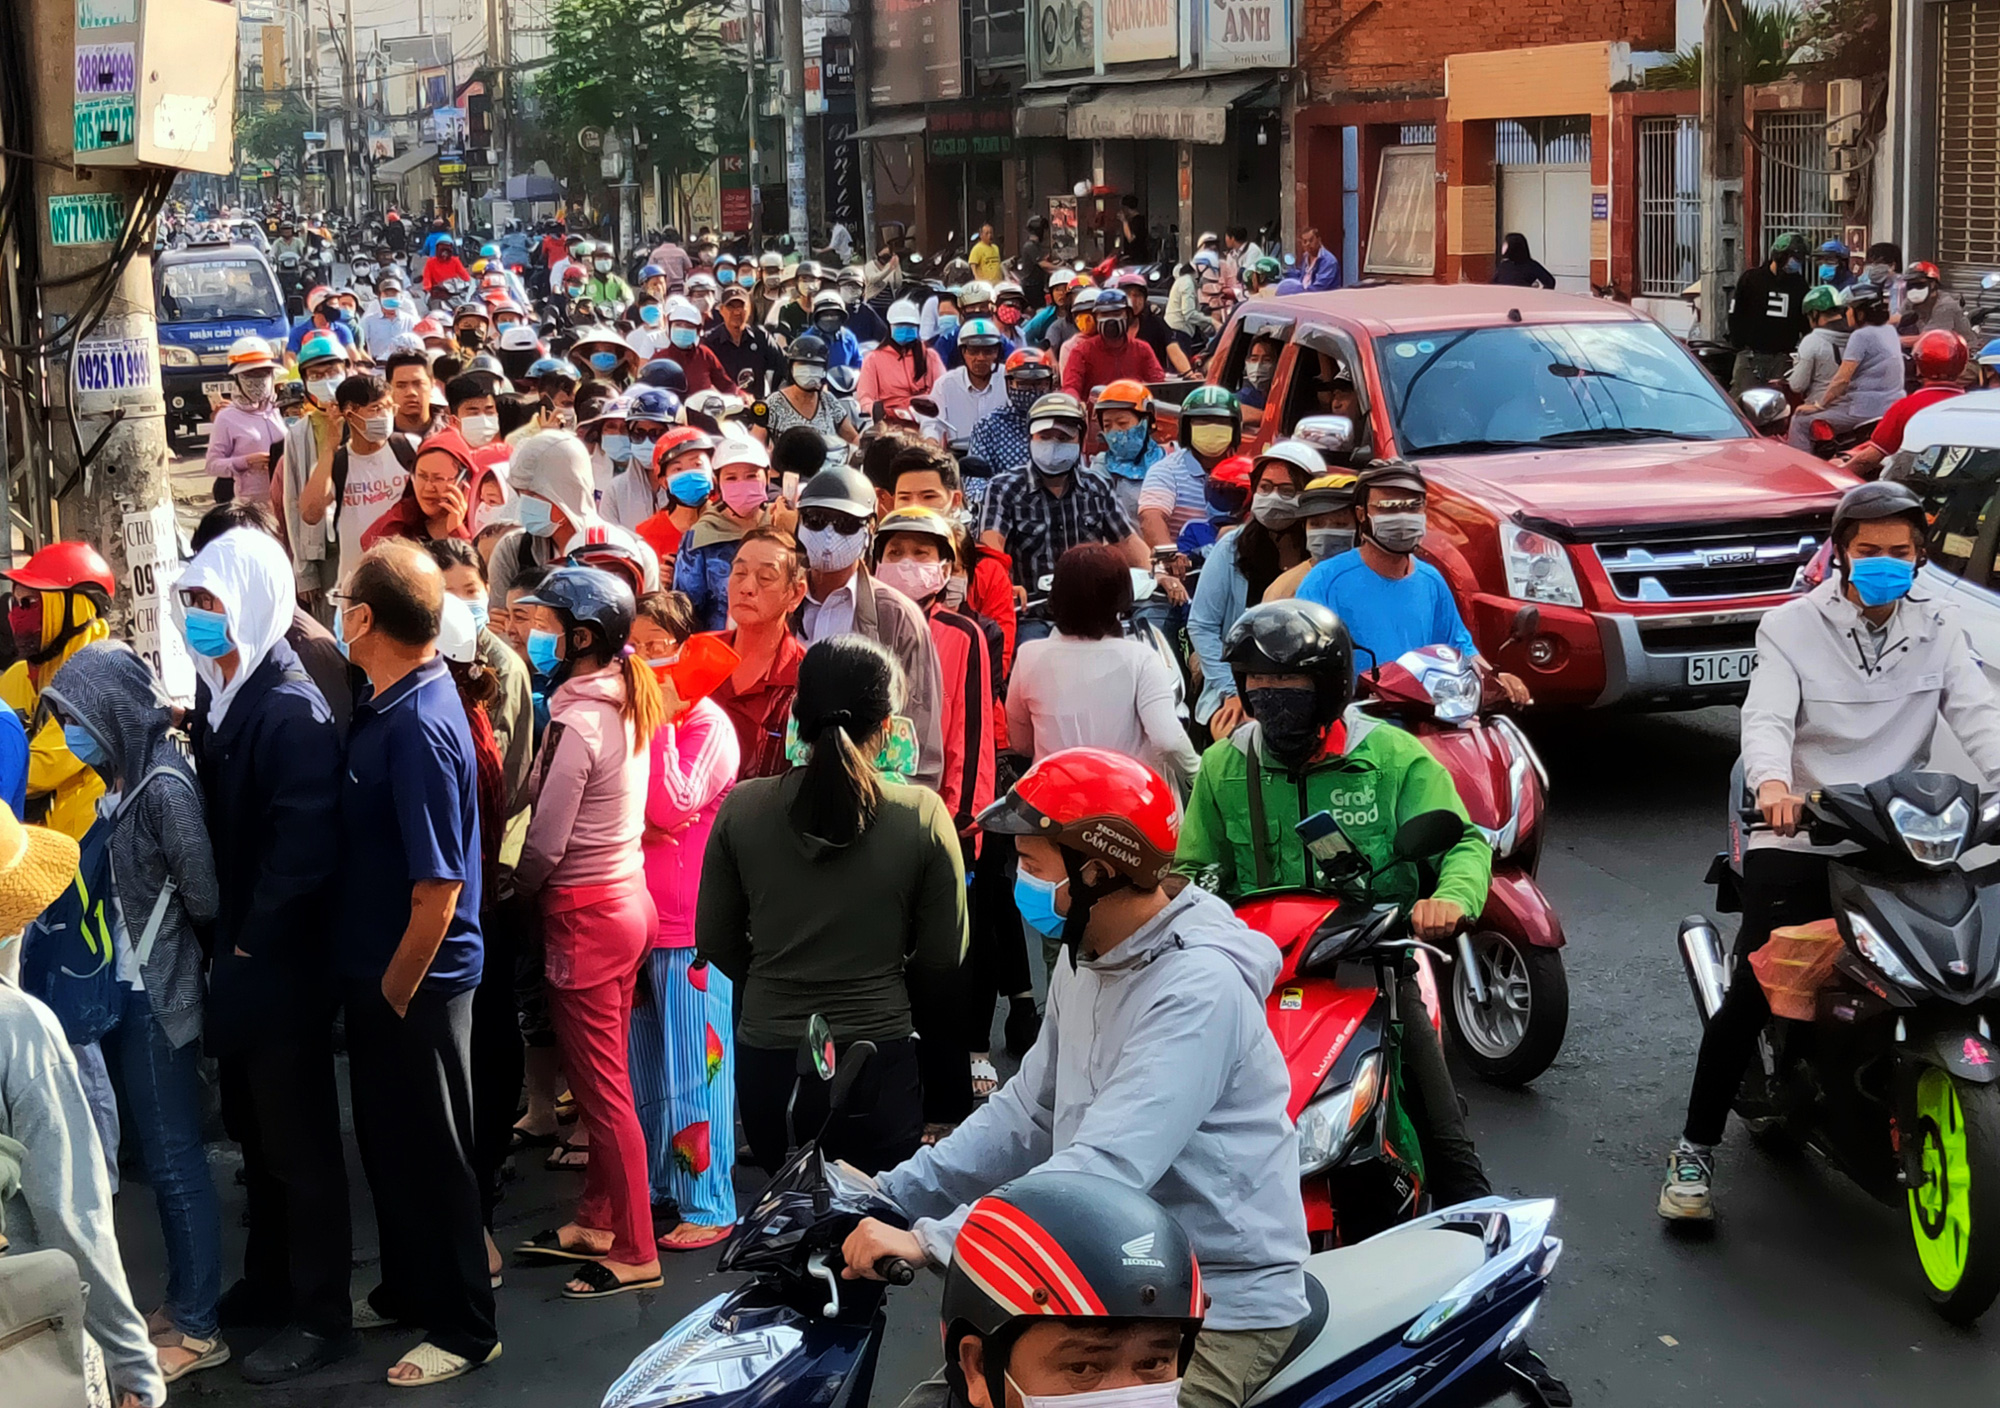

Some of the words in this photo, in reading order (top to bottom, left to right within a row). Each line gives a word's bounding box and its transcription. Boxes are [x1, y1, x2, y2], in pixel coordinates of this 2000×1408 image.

[1221, 6, 1271, 43] ANH
[1708, 552, 1753, 564] ISUZU
[1330, 784, 1376, 807] Grab
[1332, 802, 1379, 826] Food
[1095, 823, 1140, 851] HONDA
[1108, 845, 1141, 867] GIANG
[1121, 1257, 1166, 1268] HONDA
